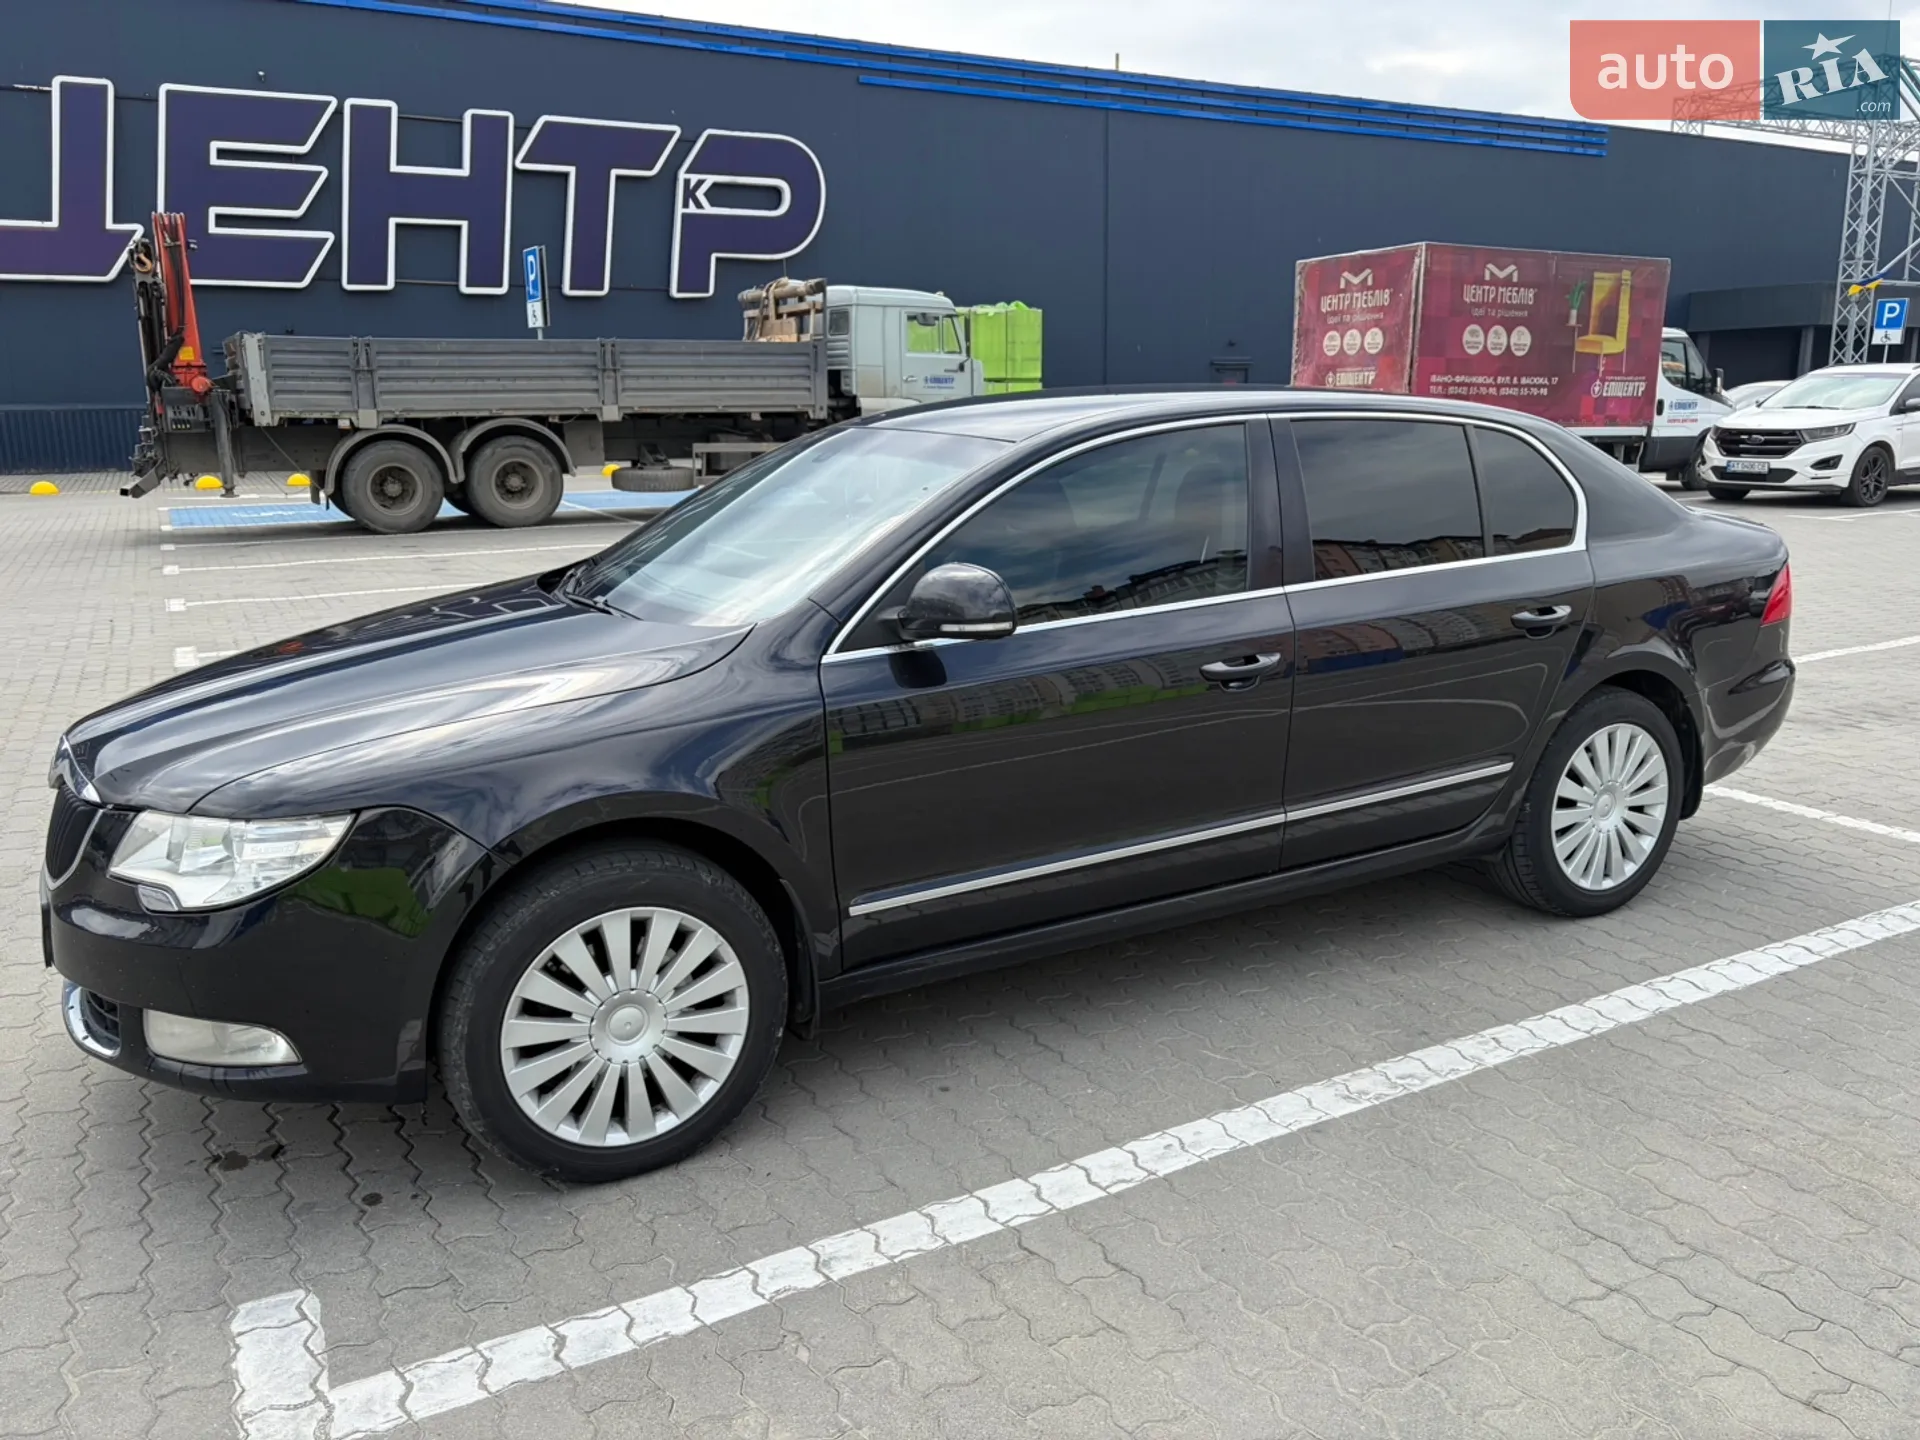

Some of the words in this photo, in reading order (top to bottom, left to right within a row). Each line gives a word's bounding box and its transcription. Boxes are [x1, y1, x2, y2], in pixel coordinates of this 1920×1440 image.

[527, 254, 536, 295] P
[1320, 292, 1351, 313] ЦЕНТР
[1352, 289, 1391, 309] МЕБЛІВ
[1463, 284, 1496, 304] ЦЕНТР
[1497, 286, 1535, 305] МЕБЛІВ
[1883, 302, 1900, 326] P
